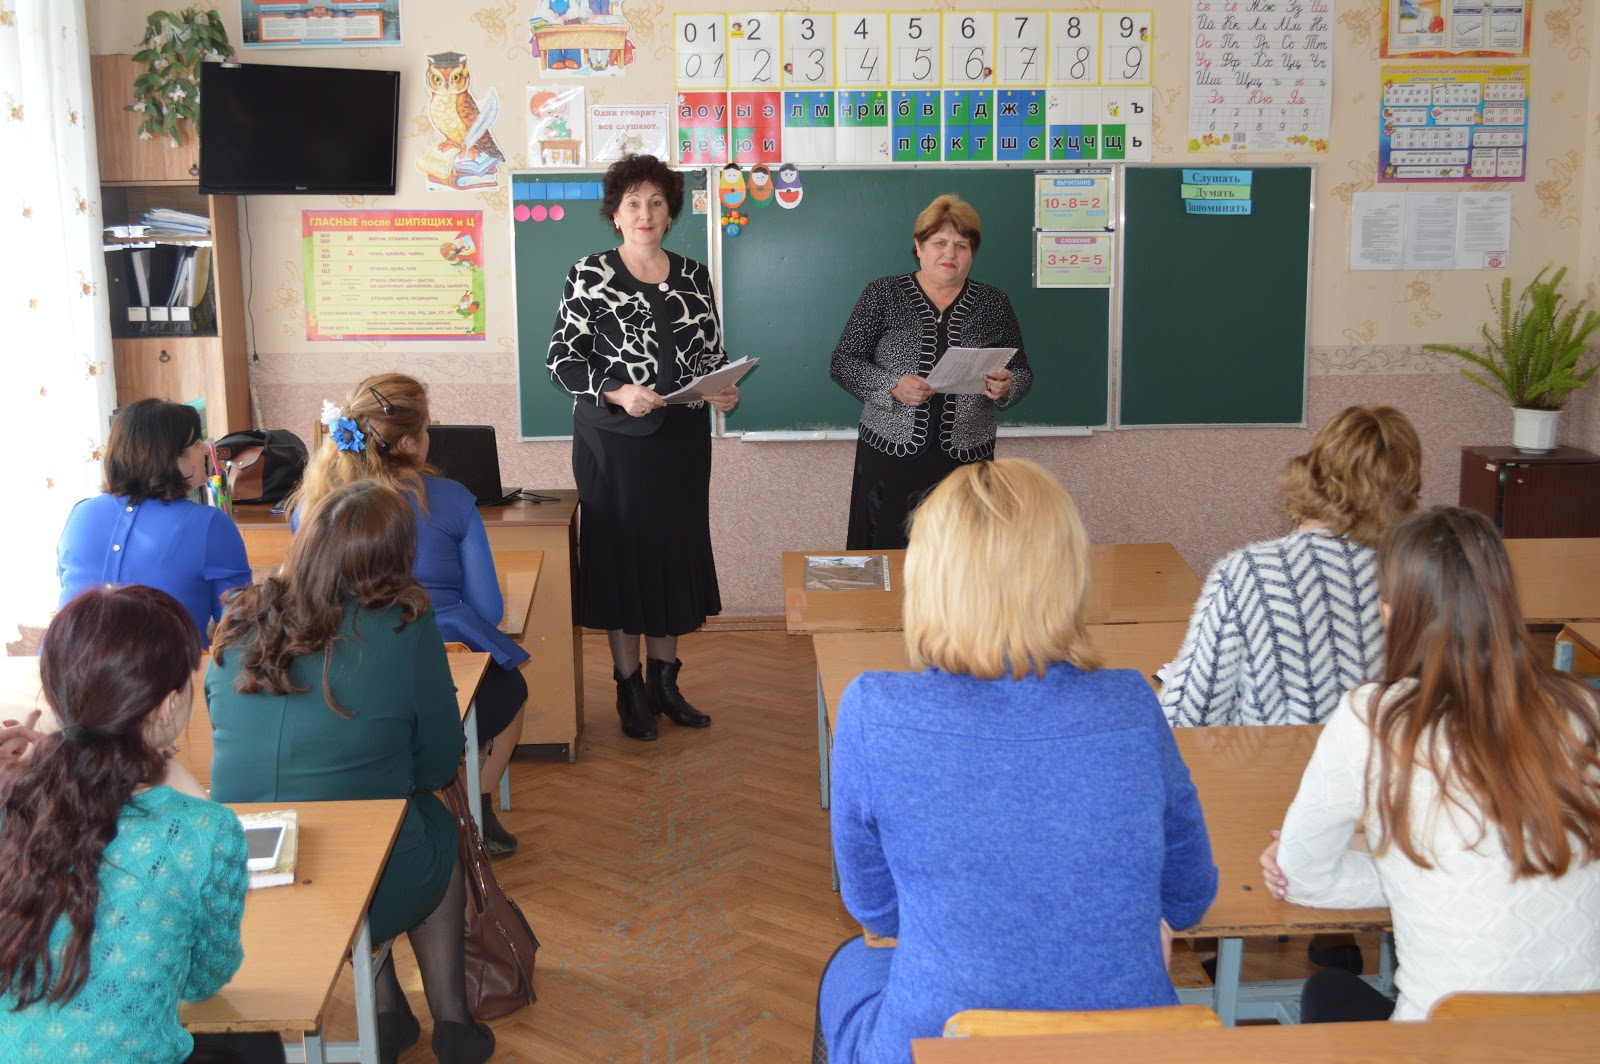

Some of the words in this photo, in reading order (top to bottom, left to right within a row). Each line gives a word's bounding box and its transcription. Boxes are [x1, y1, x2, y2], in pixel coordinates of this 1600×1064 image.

[747, 19, 761, 40] 2
[801, 19, 815, 40] 3
[854, 18, 868, 39] 4
[908, 18, 922, 39] 5
[962, 17, 975, 38] 6
[1015, 17, 1028, 38] 7
[1067, 17, 1080, 38] 8
[1120, 17, 1133, 38] 9
[752, 49, 770, 81] 2
[805, 49, 824, 81] 3
[860, 48, 878, 80] 4
[913, 48, 931, 80] 5
[966, 47, 984, 79] 6
[1020, 47, 1037, 79] 7
[1070, 47, 1089, 79] 8
[1123, 47, 1142, 79] 9
[1234, 108, 1239, 116] 2
[1257, 108, 1262, 116] 3
[1210, 123, 1215, 131] 6
[1256, 123, 1262, 131] 8
[1280, 123, 1285, 131] 9
[1302, 123, 1308, 131] 0
[1192, 173, 1240, 185] Слушать
[1195, 188, 1234, 199] Думать
[1188, 202, 1247, 212] Запоминать
[309, 218, 358, 226] ГЛАСНЫЕ
[395, 218, 453, 227] ШИПЯЩИХ
[466, 218, 475, 227] Ц
